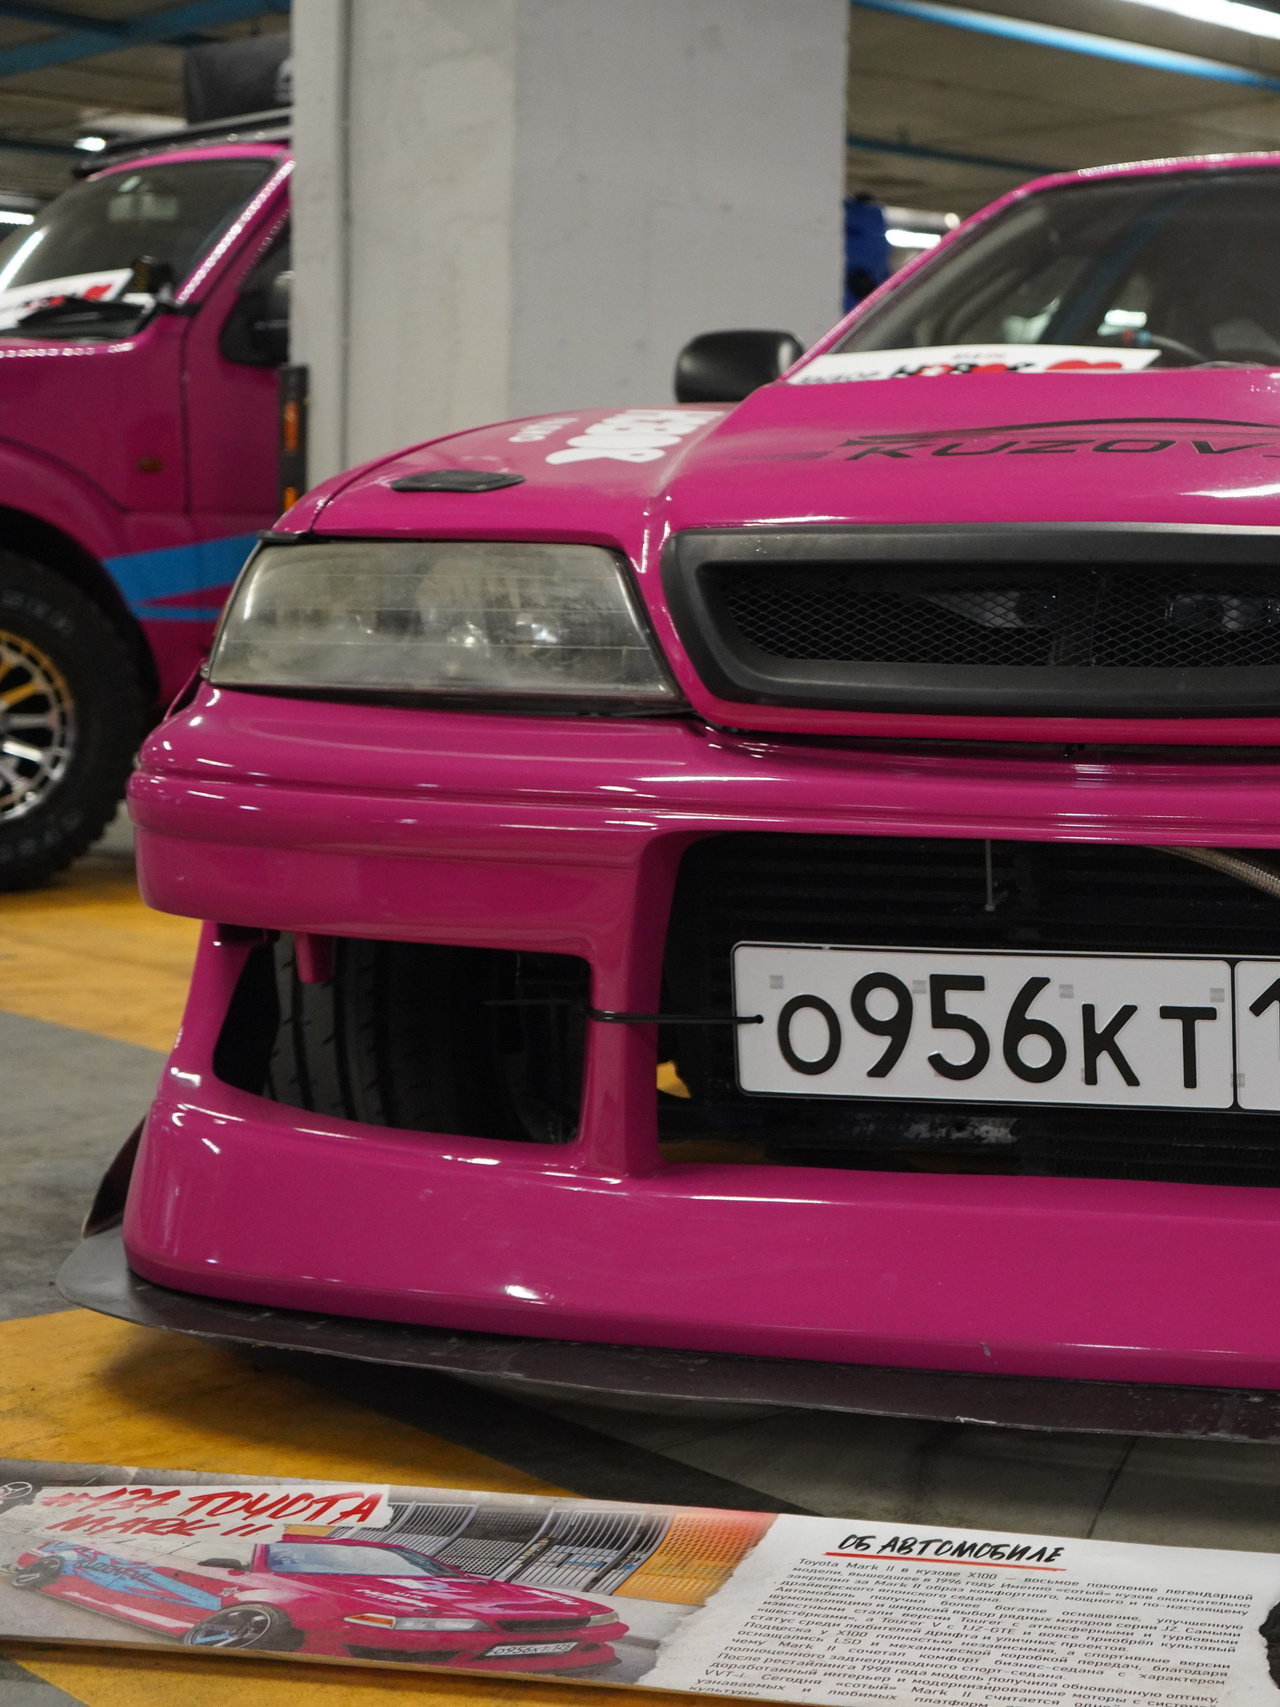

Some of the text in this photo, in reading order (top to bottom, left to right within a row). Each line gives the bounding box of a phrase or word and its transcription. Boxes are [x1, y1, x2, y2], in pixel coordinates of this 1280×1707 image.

[47, 1515, 219, 1537] MARK
[181, 1491, 383, 1525] TOYOTA
[838, 1533, 1065, 1563] ОБ АВТОМОБИЛЕ
[779, 1580, 875, 1592] драйверского
[876, 1588, 947, 1598] японского
[785, 1574, 850, 1583] закрепил
[924, 1584, 965, 1592] образ
[1064, 1596, 1124, 1605] мощного
[796, 1559, 840, 1567] Toyota
[914, 1569, 961, 1577] кузове
[1023, 1578, 1079, 1586] восьмое
[1086, 1582, 1158, 1592] поколение
[1165, 1588, 1253, 1600] легендарной
[846, 1572, 920, 1582] вышедшее
[1000, 1582, 1052, 1591] Именно
[1156, 1596, 1251, 1607] окончательно
[761, 1601, 846, 1611] известными
[900, 1613, 951, 1621] версии
[958, 1616, 1002, 1625] Tourer
[1027, 1622, 1134, 1637] атмосферными
[1161, 1633, 1238, 1646] турбовыми
[767, 1594, 873, 1607] шумоизоляцию
[886, 1603, 950, 1614] широкий
[950, 1608, 997, 1618] выбор
[998, 1613, 1051, 1622] рядных
[1055, 1618, 1112, 1627] моторов
[1115, 1623, 1157, 1631] серии
[1184, 1627, 1241, 1637] Самыми
[774, 1586, 857, 1597] Автомобиль
[868, 1595, 926, 1604] получил
[939, 1600, 981, 1608] более
[994, 1604, 1048, 1613] богатое
[1155, 1618, 1244, 1630] улучшенную
[742, 1622, 813, 1633] Подвеска
[874, 1634, 953, 1644] полностью
[1083, 1652, 1170, 1664] спортивные
[1178, 1660, 1230, 1670] версии
[748, 1615, 795, 1623] статус
[796, 1620, 841, 1628] среди
[844, 1622, 922, 1633] любителей
[923, 1629, 980, 1640] дрифта
[994, 1636, 1056, 1646] уличных
[879, 1617, 923, 1625] Tourer
[1160, 1641, 1236, 1654] культовый
[735, 1630, 825, 1643] оснащались
[832, 1637, 862, 1645] LSD
[888, 1642, 992, 1656] механической
[999, 1652, 1069, 1664] коробкой
[1151, 1665, 1228, 1678] благодаря
